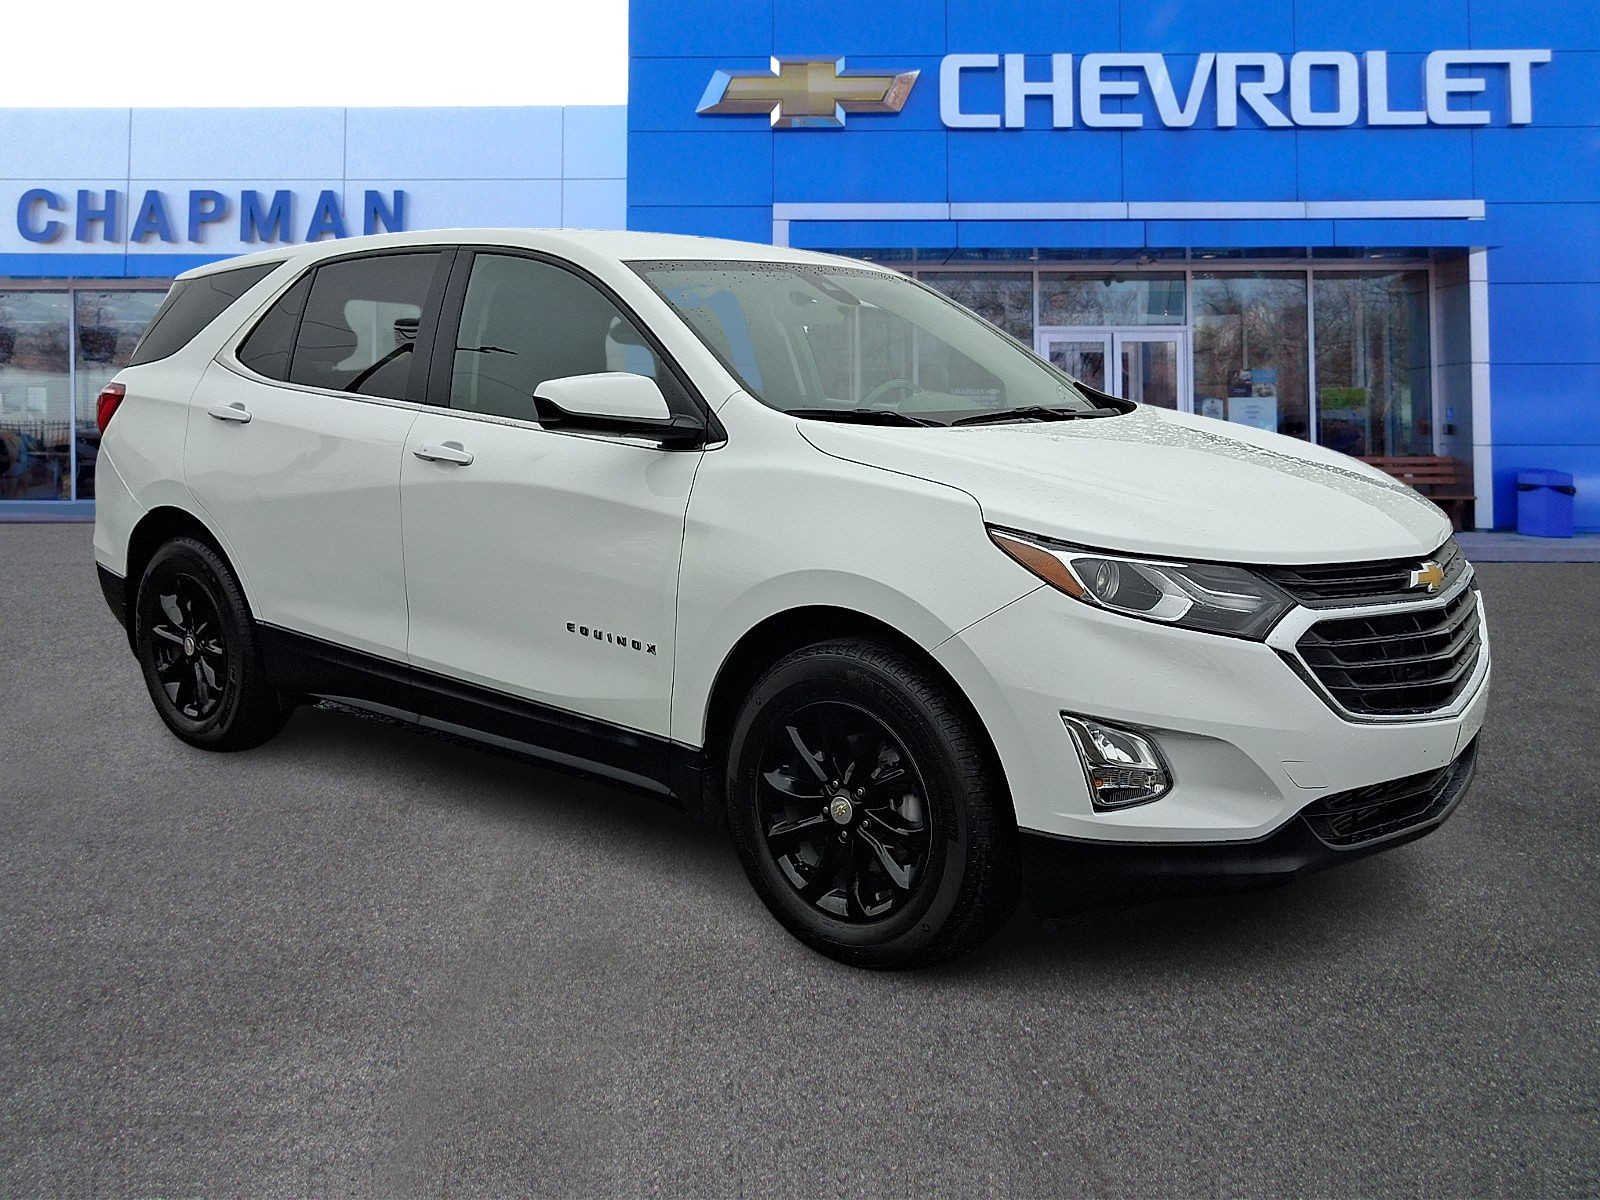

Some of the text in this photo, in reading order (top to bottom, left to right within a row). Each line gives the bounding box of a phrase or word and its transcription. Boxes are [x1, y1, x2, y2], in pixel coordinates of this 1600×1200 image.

[939, 49, 1551, 128] CHEVROLET
[16, 188, 406, 243] CHAPMAN
[566, 622, 657, 656] EQUINOX
